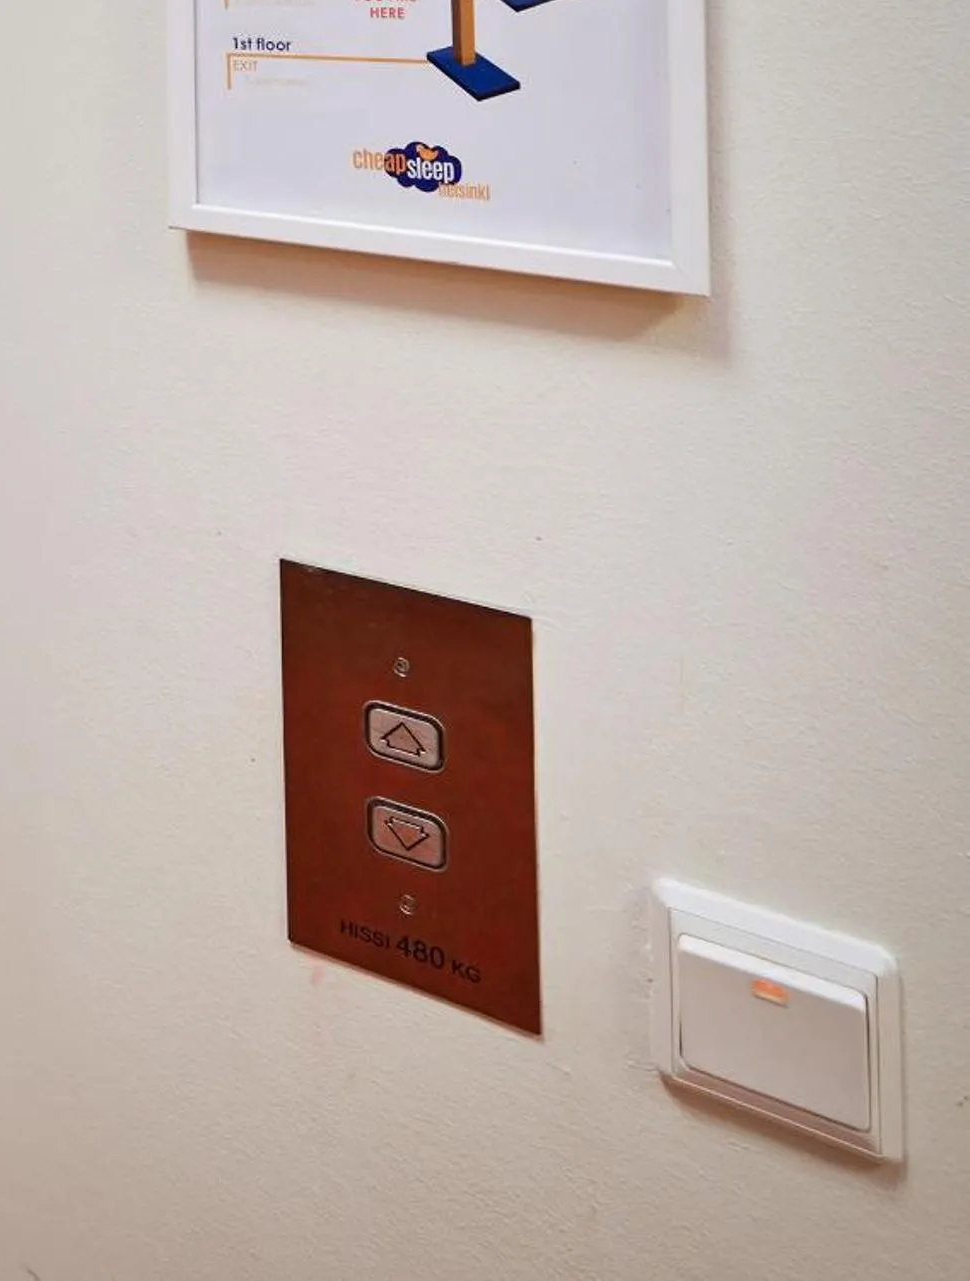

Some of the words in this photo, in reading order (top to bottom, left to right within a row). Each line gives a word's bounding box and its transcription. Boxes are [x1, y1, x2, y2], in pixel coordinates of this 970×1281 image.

[369, 6, 406, 19] HERE
[232, 36, 252, 51] 1st
[256, 37, 292, 52] floor
[233, 60, 258, 72] EXIT
[340, 920, 390, 950] HISSI
[396, 935, 445, 970] 480
[451, 959, 481, 984] KG
